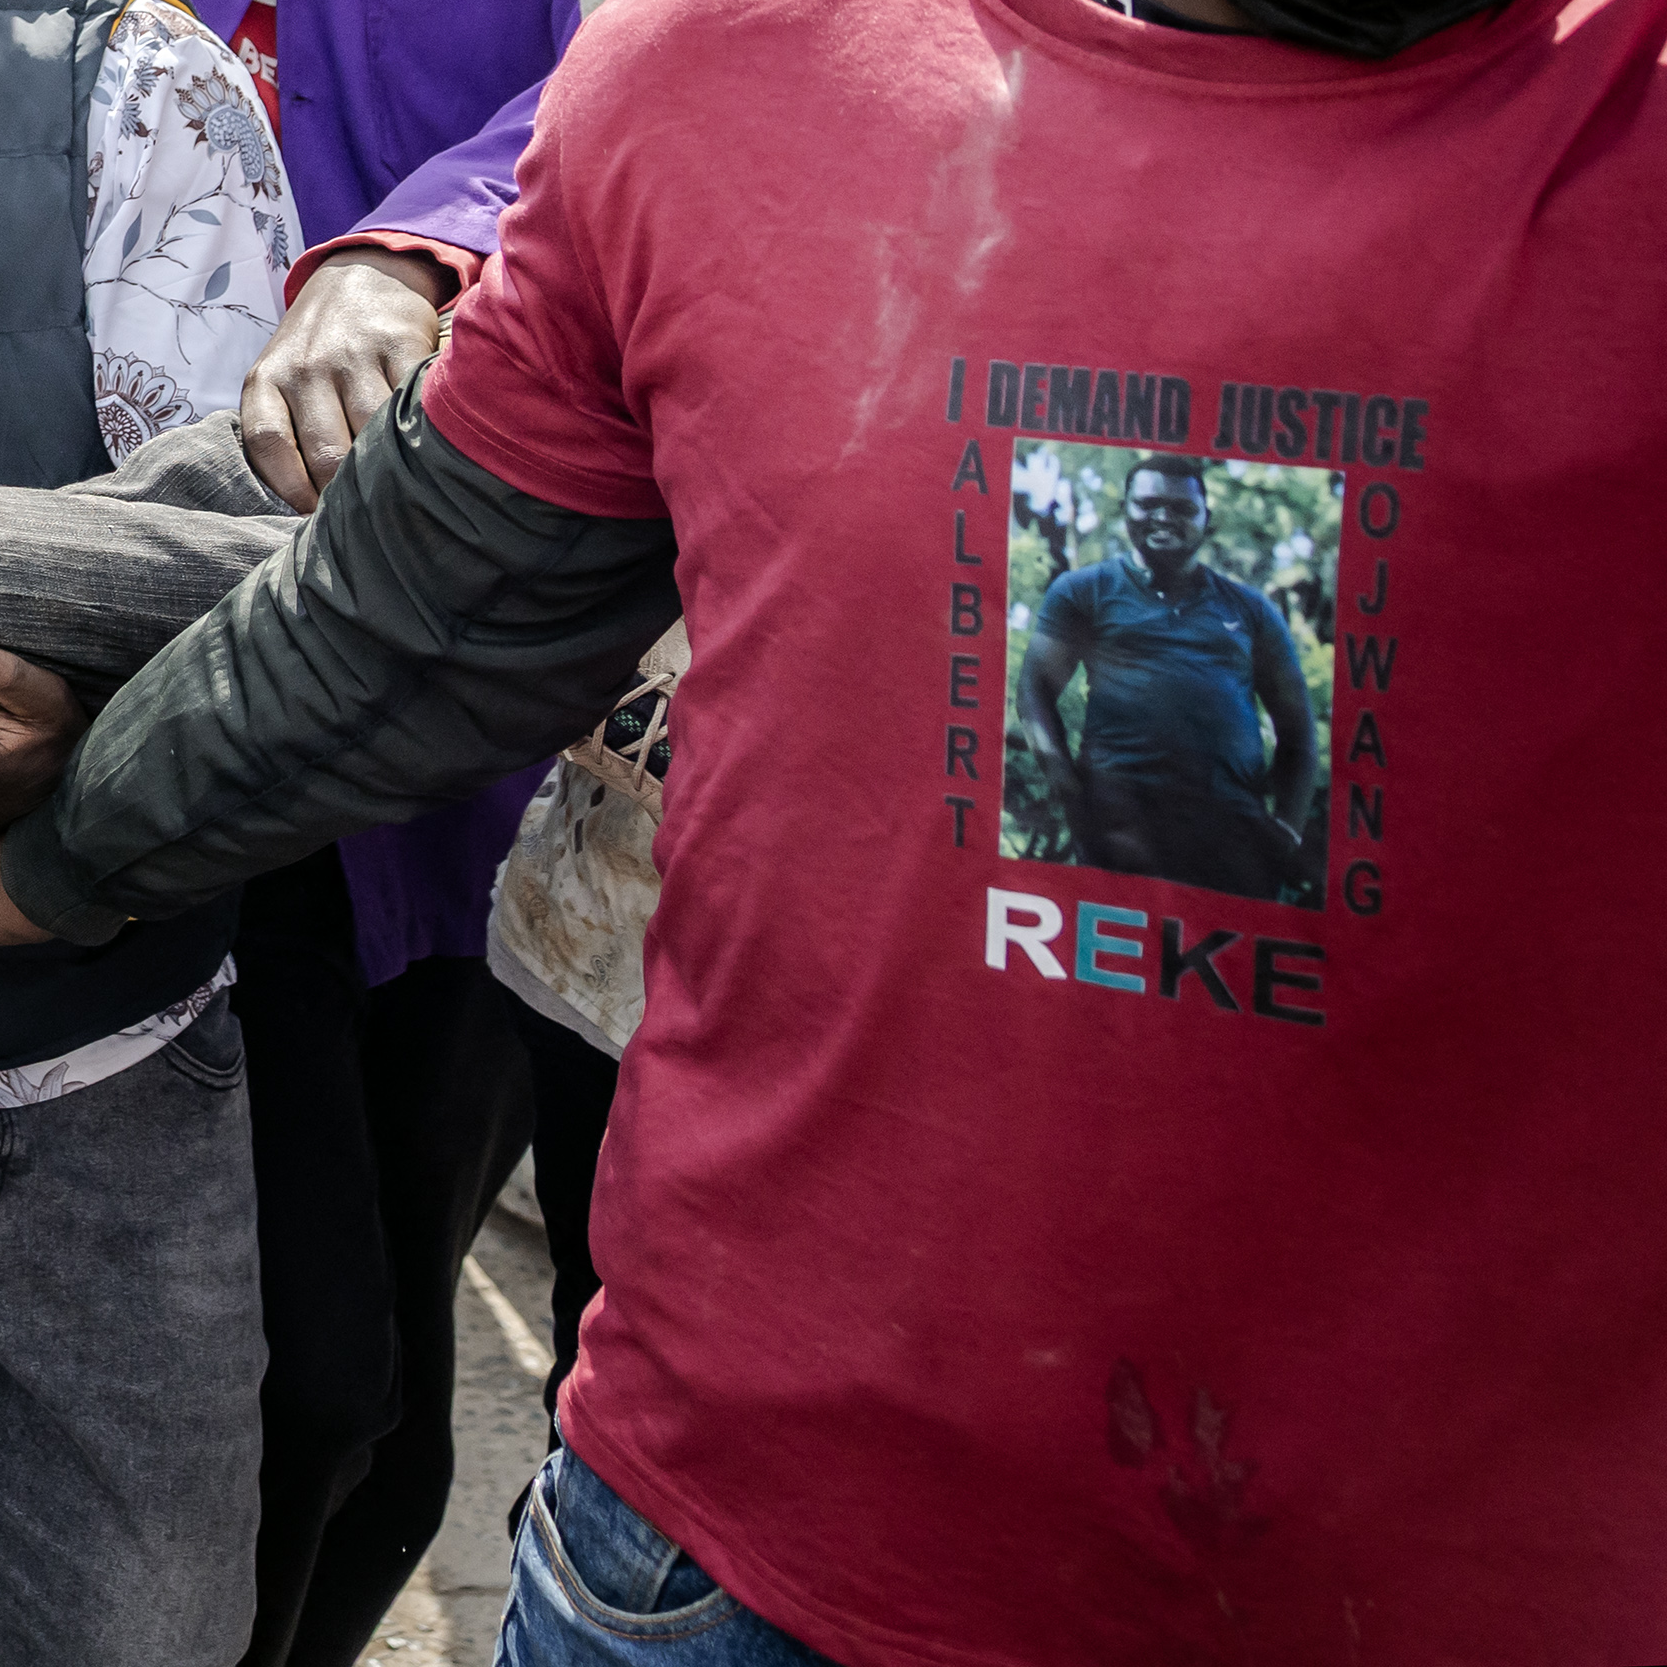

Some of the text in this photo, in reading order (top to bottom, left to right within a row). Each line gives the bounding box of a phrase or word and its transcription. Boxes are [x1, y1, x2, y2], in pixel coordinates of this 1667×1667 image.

[946, 357, 1430, 471] I DEMAND JUSTICE
[944, 439, 989, 848] ALBERT
[1342, 482, 1402, 917] OJWANG
[983, 885, 1327, 1027] REKE
